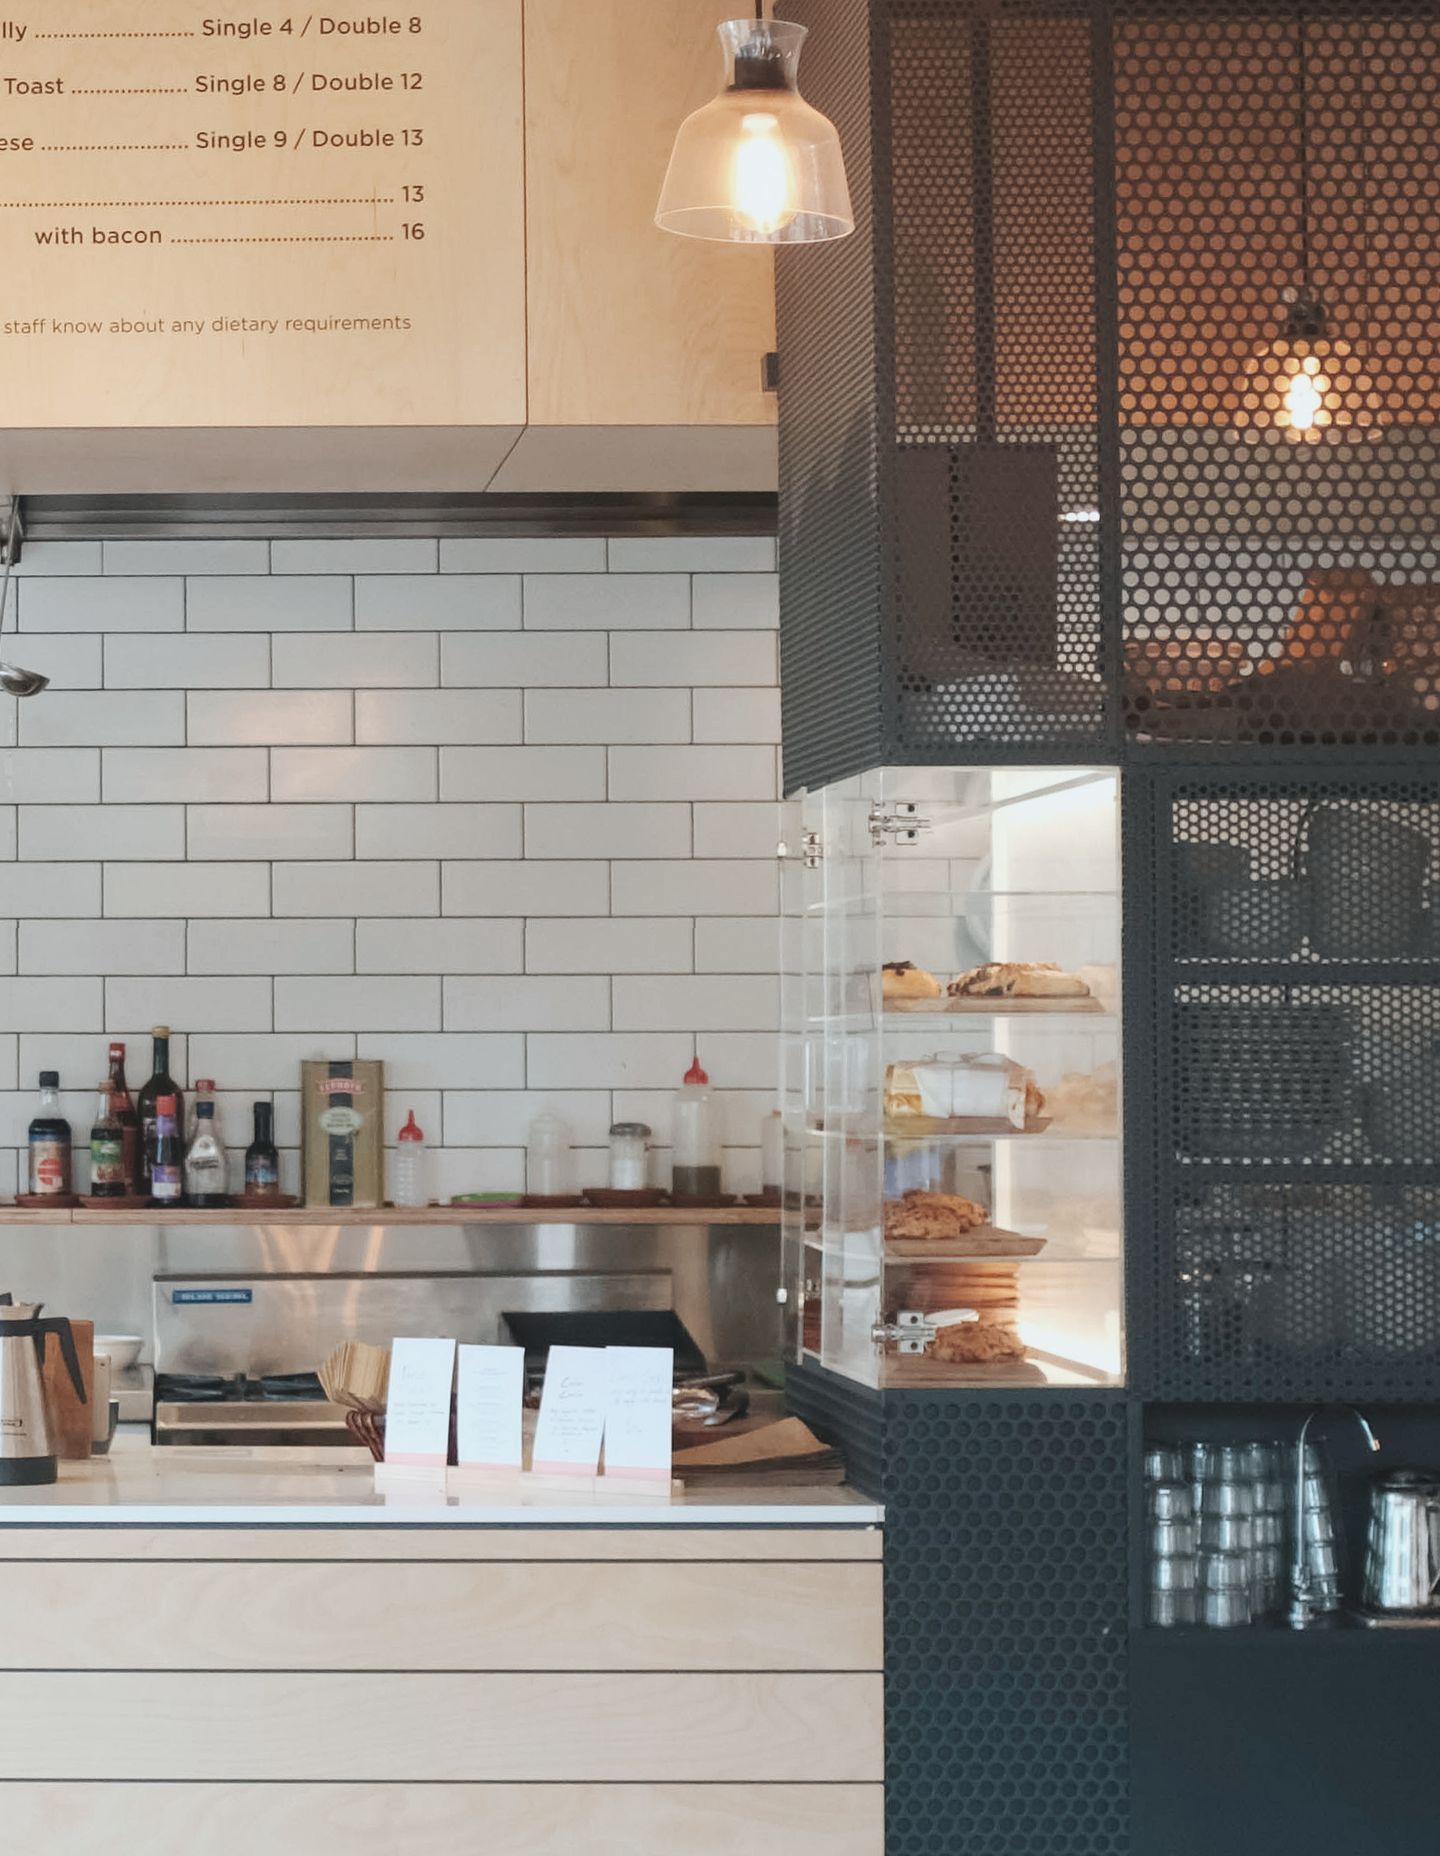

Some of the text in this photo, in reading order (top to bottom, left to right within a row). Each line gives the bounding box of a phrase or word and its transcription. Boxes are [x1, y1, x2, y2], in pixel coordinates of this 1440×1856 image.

[201, 17, 272, 39] Single
[279, 18, 294, 35] 4
[300, 15, 313, 38] /
[319, 16, 402, 35] Double
[408, 17, 422, 34] 8
[3, 78, 65, 96] Toast
[196, 74, 265, 95] Single
[272, 74, 287, 92] 8
[292, 72, 305, 94] /
[312, 73, 394, 91] Double
[400, 73, 423, 91] 12
[196, 130, 266, 152] Single
[273, 131, 288, 148] 9
[294, 128, 307, 150] /
[313, 129, 395, 147] Double
[401, 129, 424, 147] 13
[401, 185, 424, 203] 13
[35, 223, 425, 245] with bacon 16
[3, 318, 46, 335] staff
[52, 318, 104, 334] know
[109, 317, 165, 334] about
[171, 320, 206, 337] any
[212, 316, 279, 337] dietary
[285, 315, 412, 336] requirements
